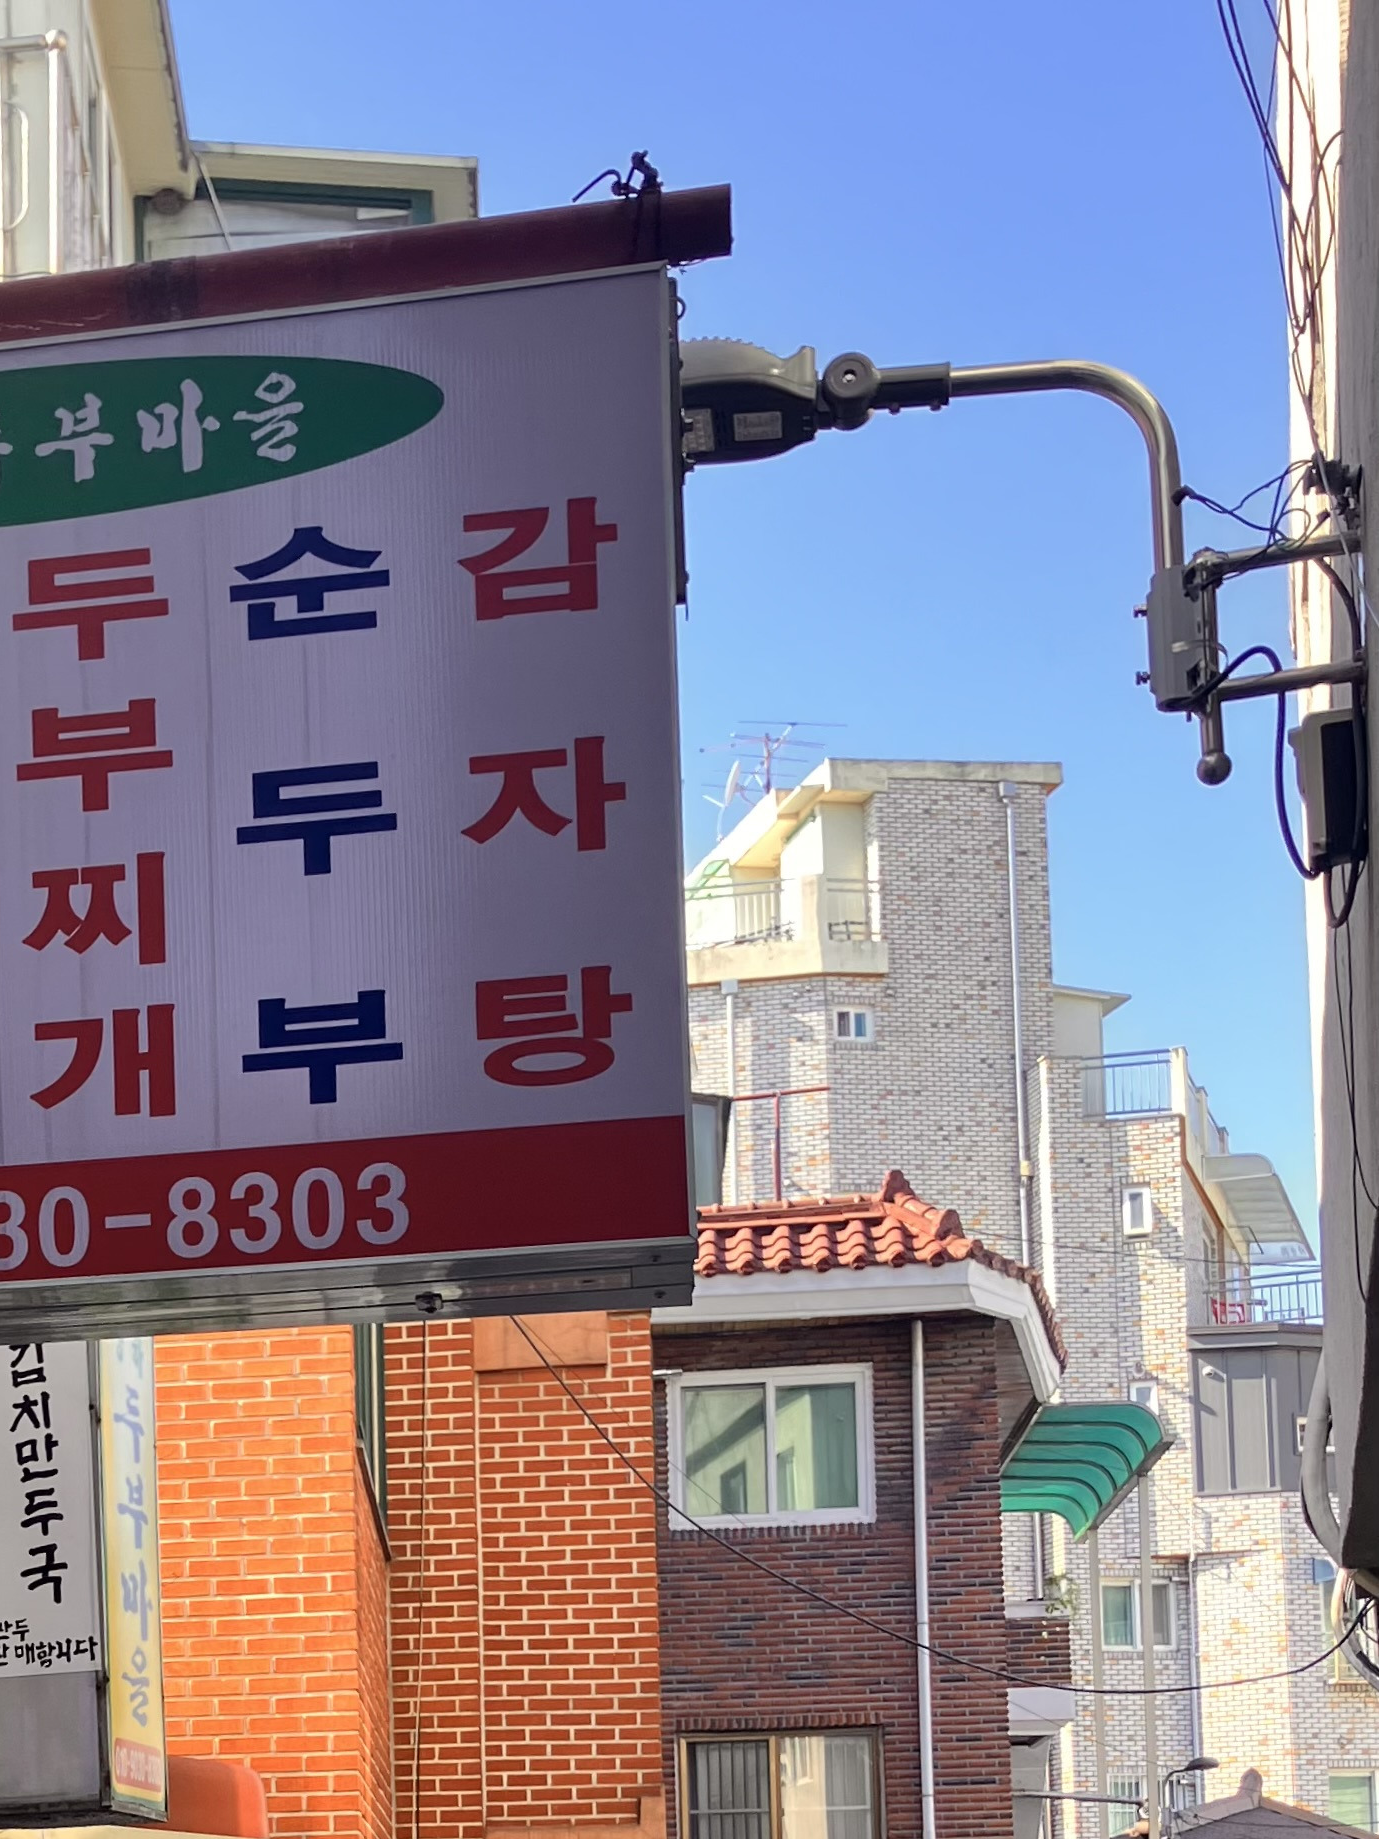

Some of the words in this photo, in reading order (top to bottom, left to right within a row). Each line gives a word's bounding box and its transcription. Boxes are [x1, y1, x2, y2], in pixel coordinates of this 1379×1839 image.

[13, 548, 176, 1117] 두부찌개
[230, 526, 404, 1104] 순두부
[458, 496, 633, 1086] 감자탕
[9, 1343, 68, 1604] 김치만두국
